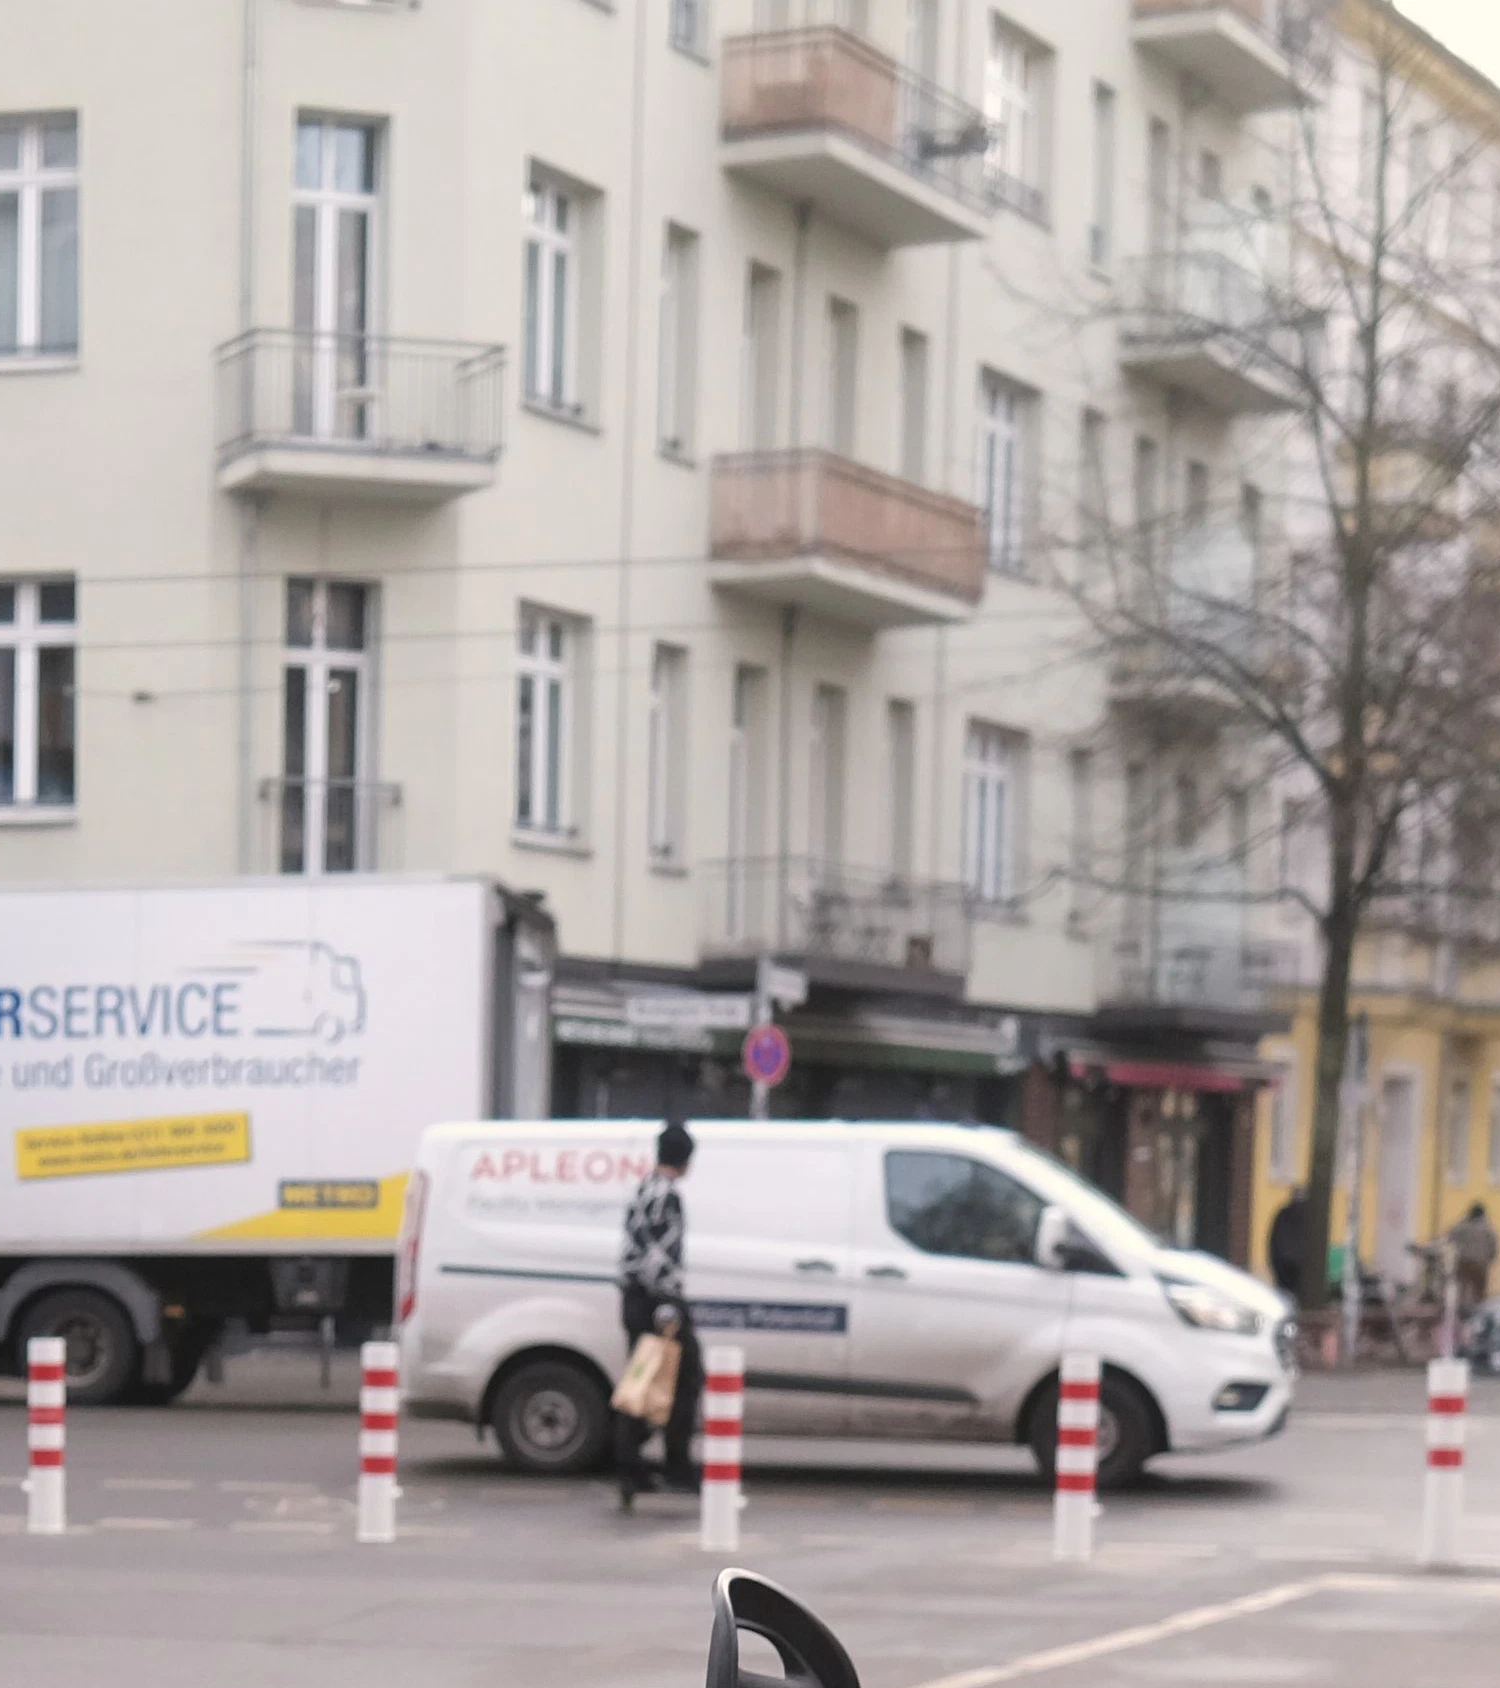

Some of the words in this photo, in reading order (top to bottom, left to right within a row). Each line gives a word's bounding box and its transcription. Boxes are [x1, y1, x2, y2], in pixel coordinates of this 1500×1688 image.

[11, 1052, 75, 1090] und
[83, 1050, 363, 1089] Großverbraucher
[471, 1148, 653, 1184] APLEON
[284, 1183, 373, 1205] METRO
